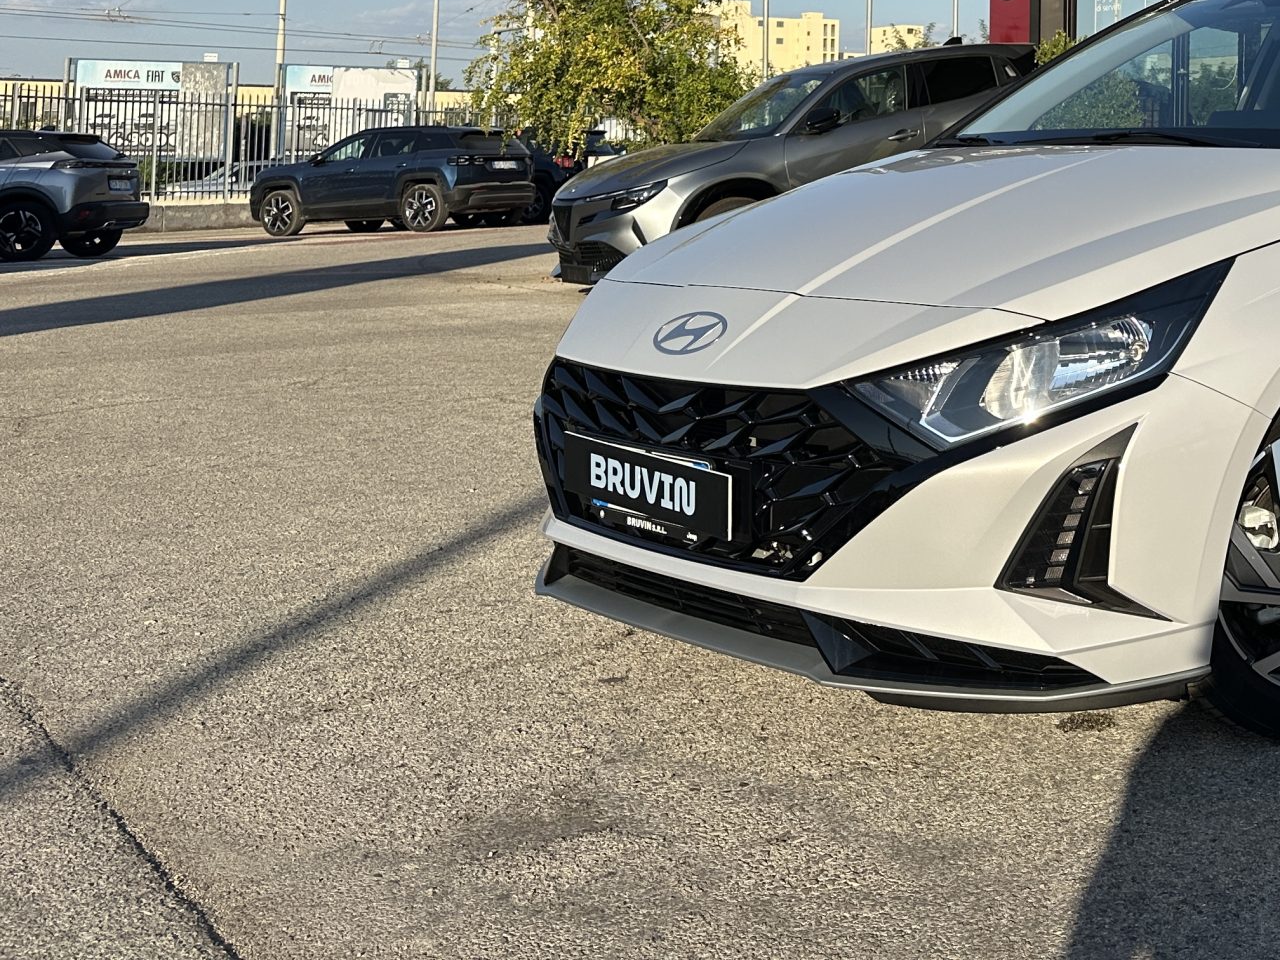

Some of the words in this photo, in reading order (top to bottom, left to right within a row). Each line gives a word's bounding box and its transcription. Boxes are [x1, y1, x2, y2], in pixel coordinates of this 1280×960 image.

[104, 69, 140, 79] AMICA
[146, 70, 165, 83] FIAT
[590, 453, 696, 516] BRUVIN
[627, 516, 652, 531] BRUVIN
